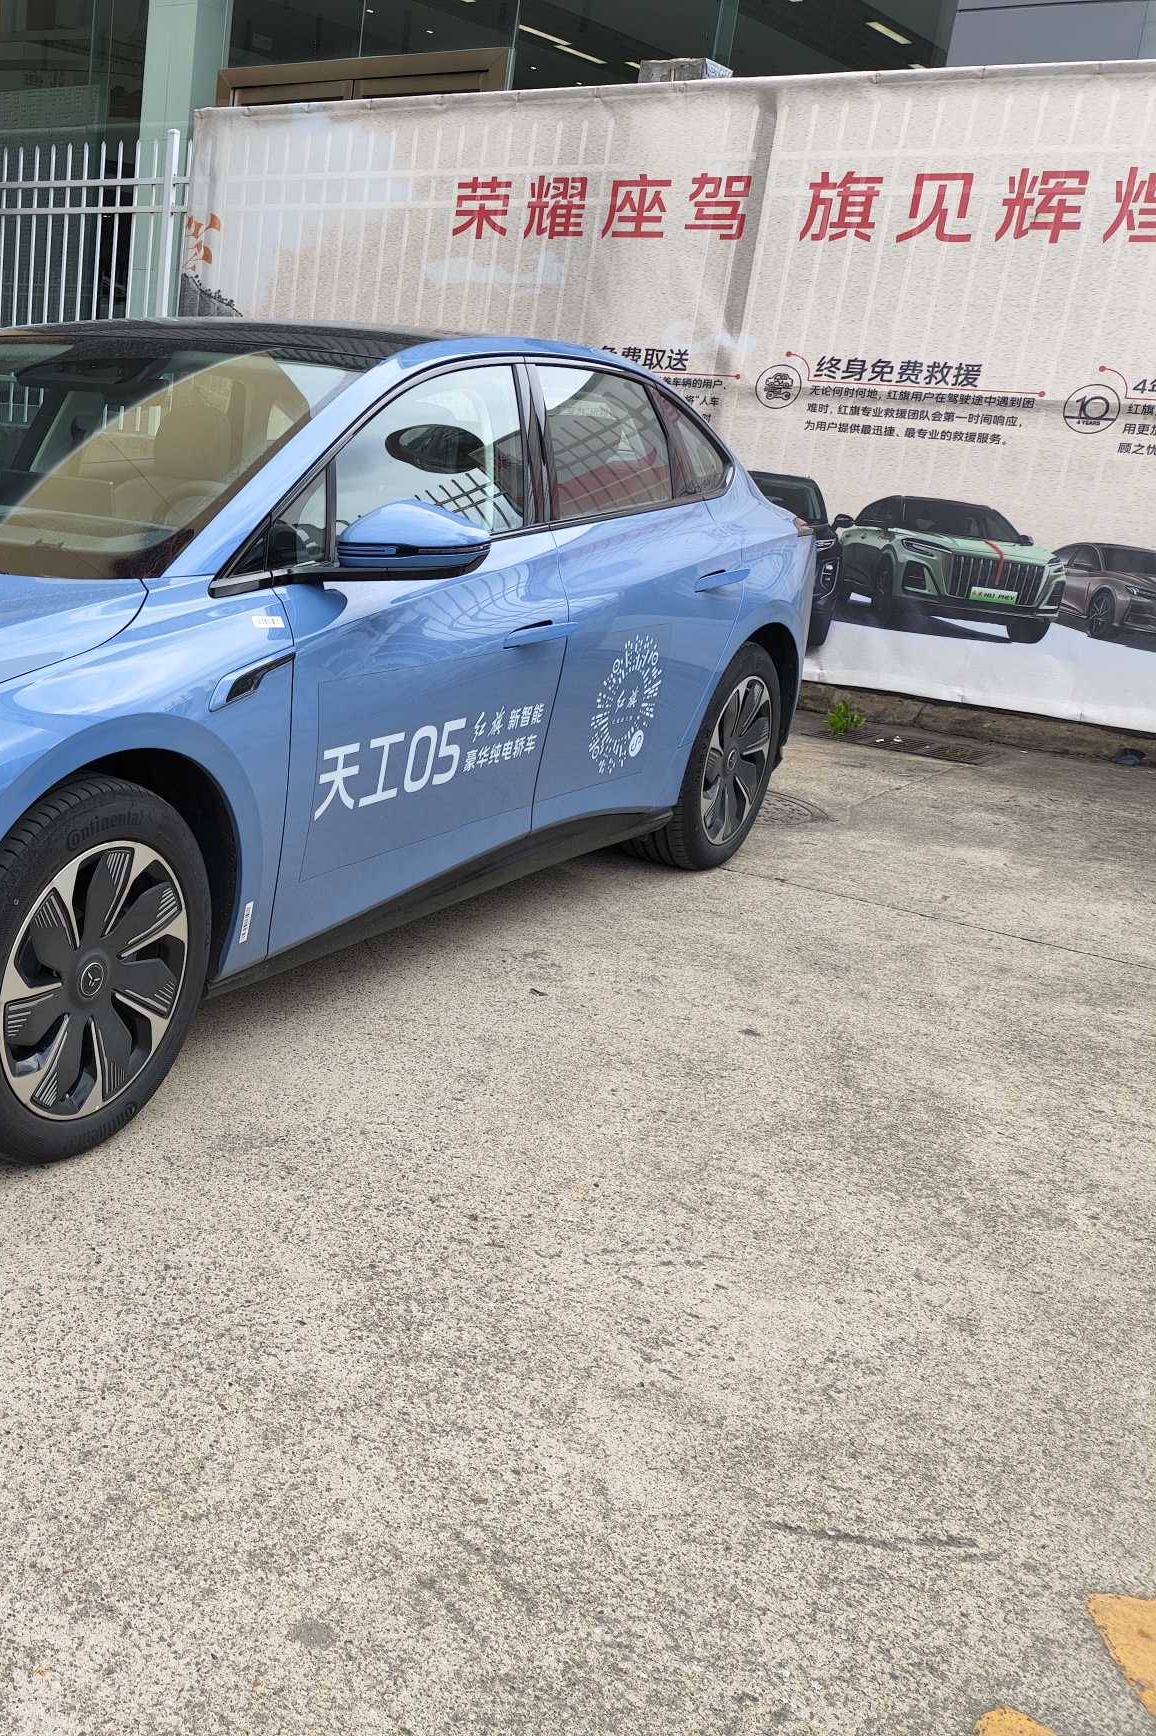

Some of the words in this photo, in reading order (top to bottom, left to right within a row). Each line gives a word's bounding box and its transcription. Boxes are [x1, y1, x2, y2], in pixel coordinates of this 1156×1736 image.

[452, 172, 752, 240] 荣耀座驾
[799, 167, 1156, 243] 旗见辉煌
[813, 355, 982, 388] 终身免费救援
[314, 717, 467, 821] 天工05
[507, 703, 545, 730] 新智能
[463, 734, 538, 772] 豪华纯电轿车
